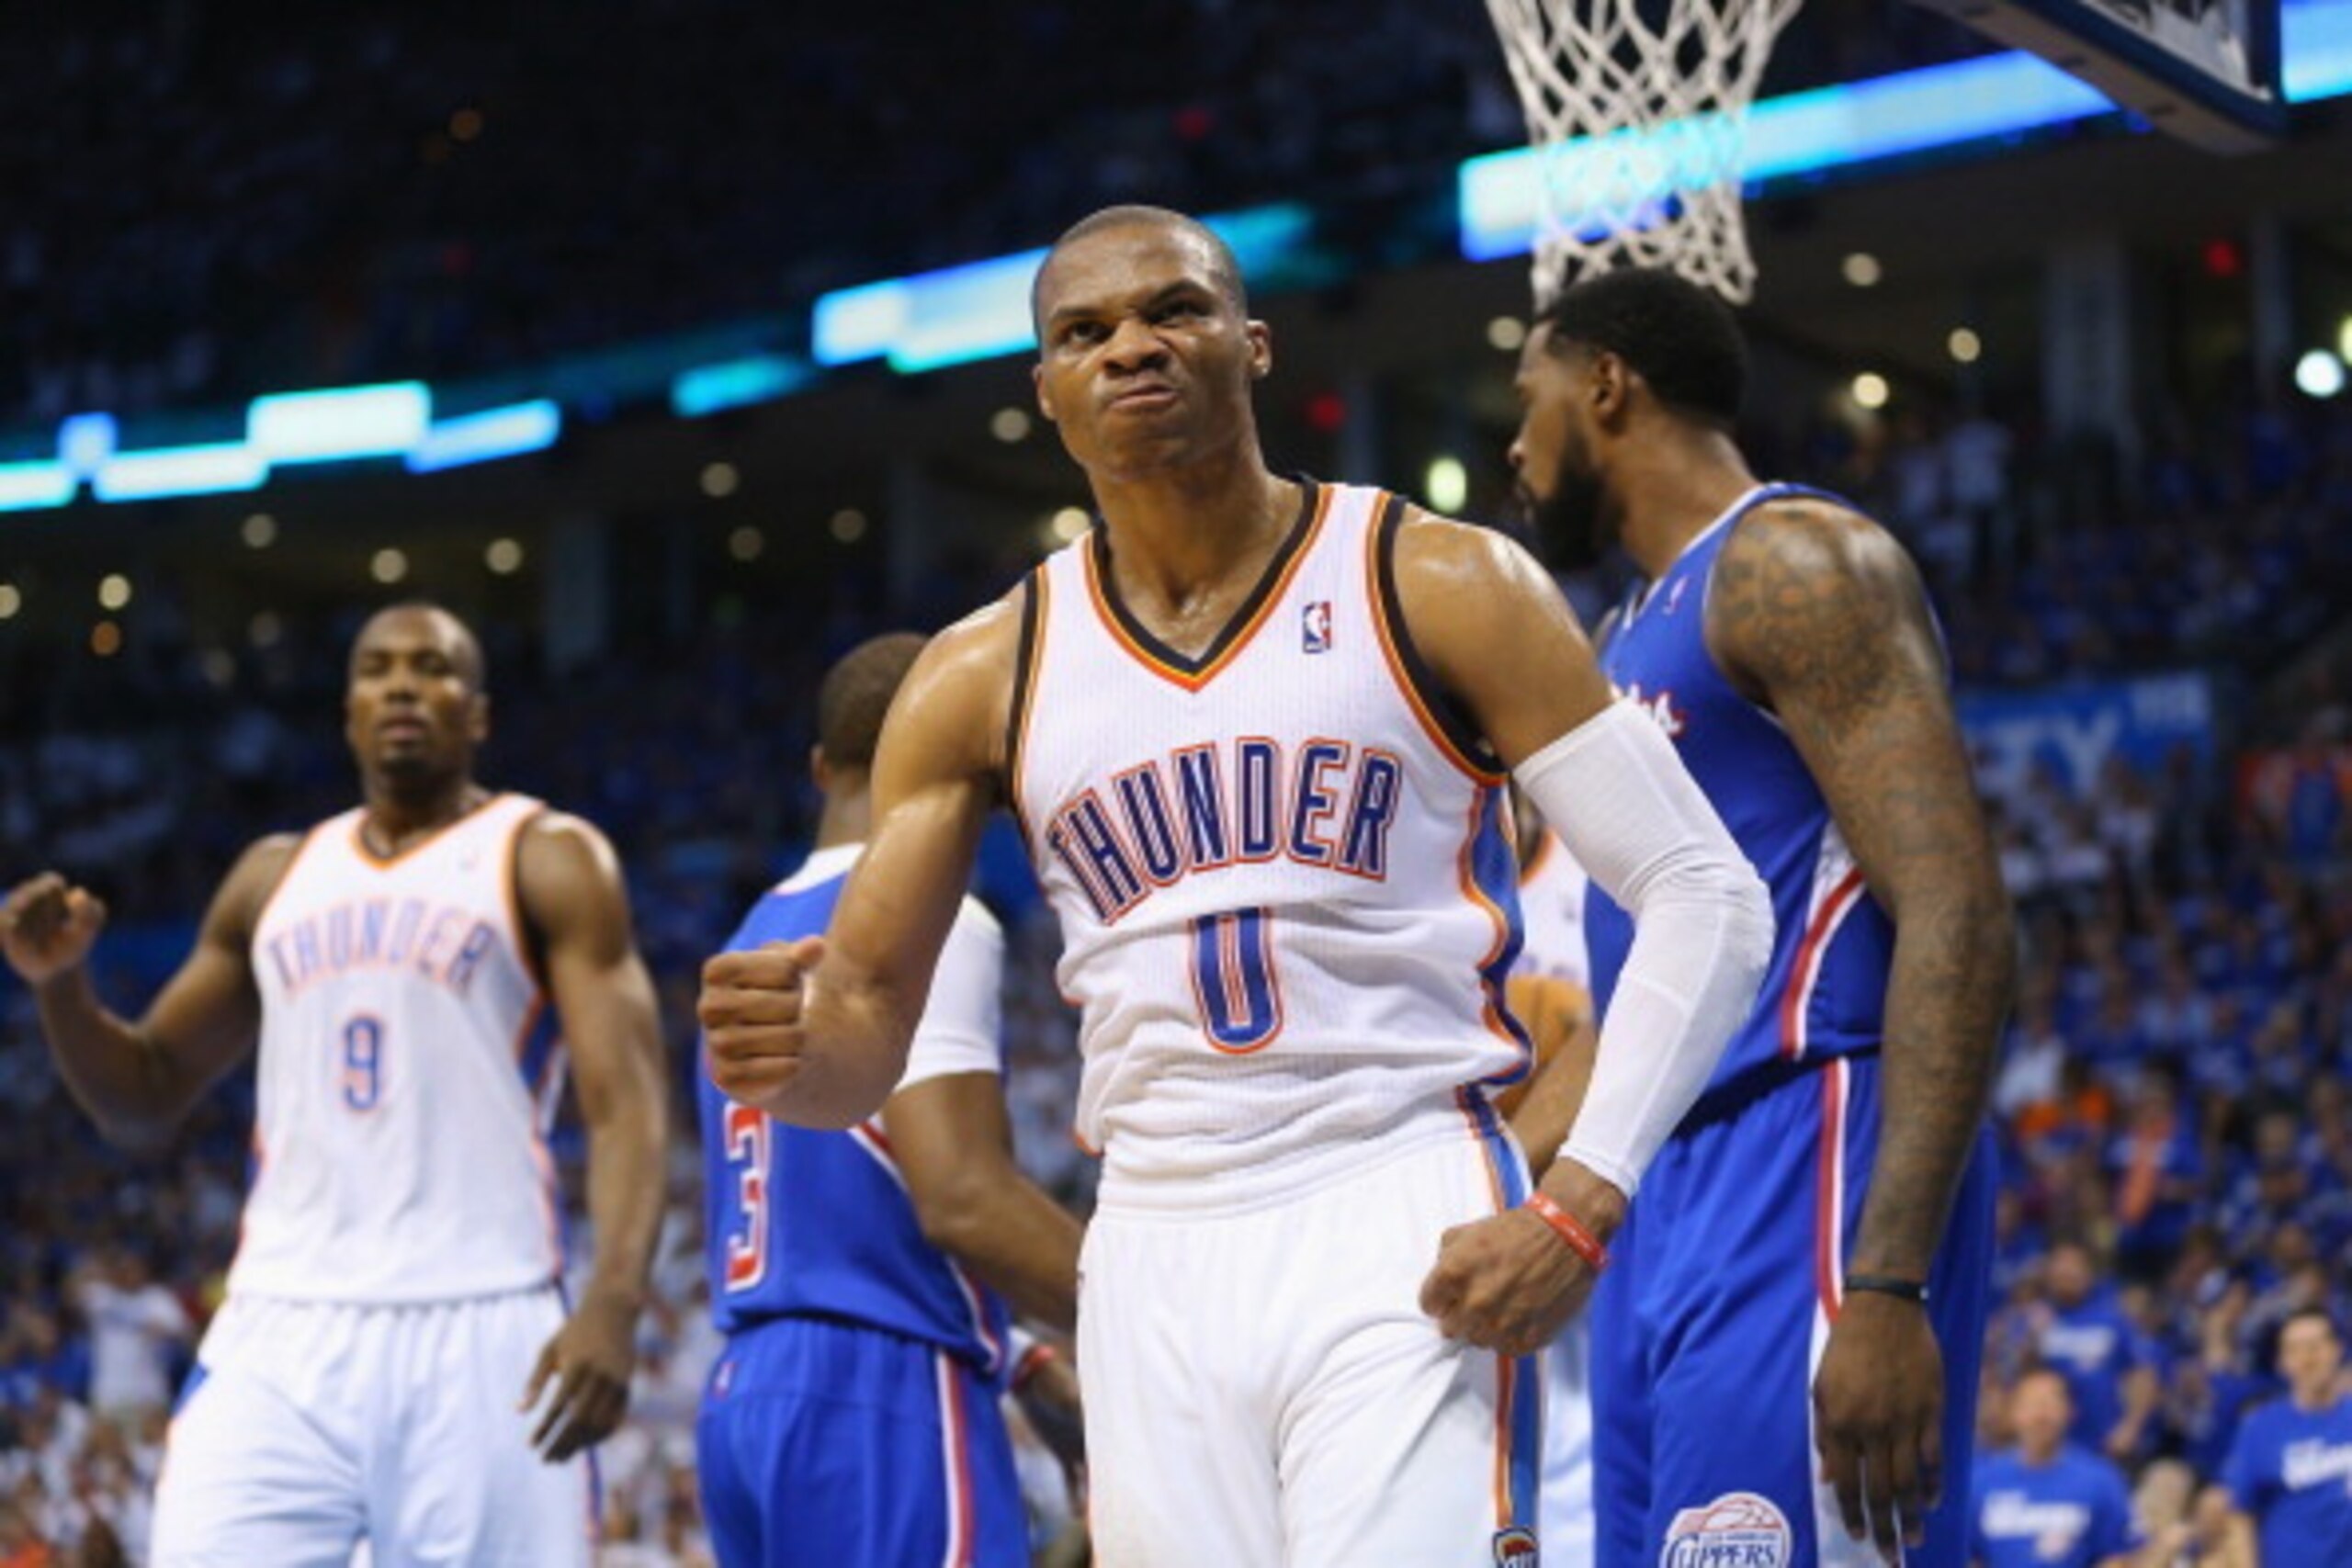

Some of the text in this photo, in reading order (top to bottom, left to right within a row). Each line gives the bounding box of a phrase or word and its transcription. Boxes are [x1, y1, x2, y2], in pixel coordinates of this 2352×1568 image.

[1046, 736, 1402, 927] THUNDER
[268, 896, 497, 998] THUNDER
[341, 1010, 386, 1114] 9
[724, 1100, 774, 1293] 3
